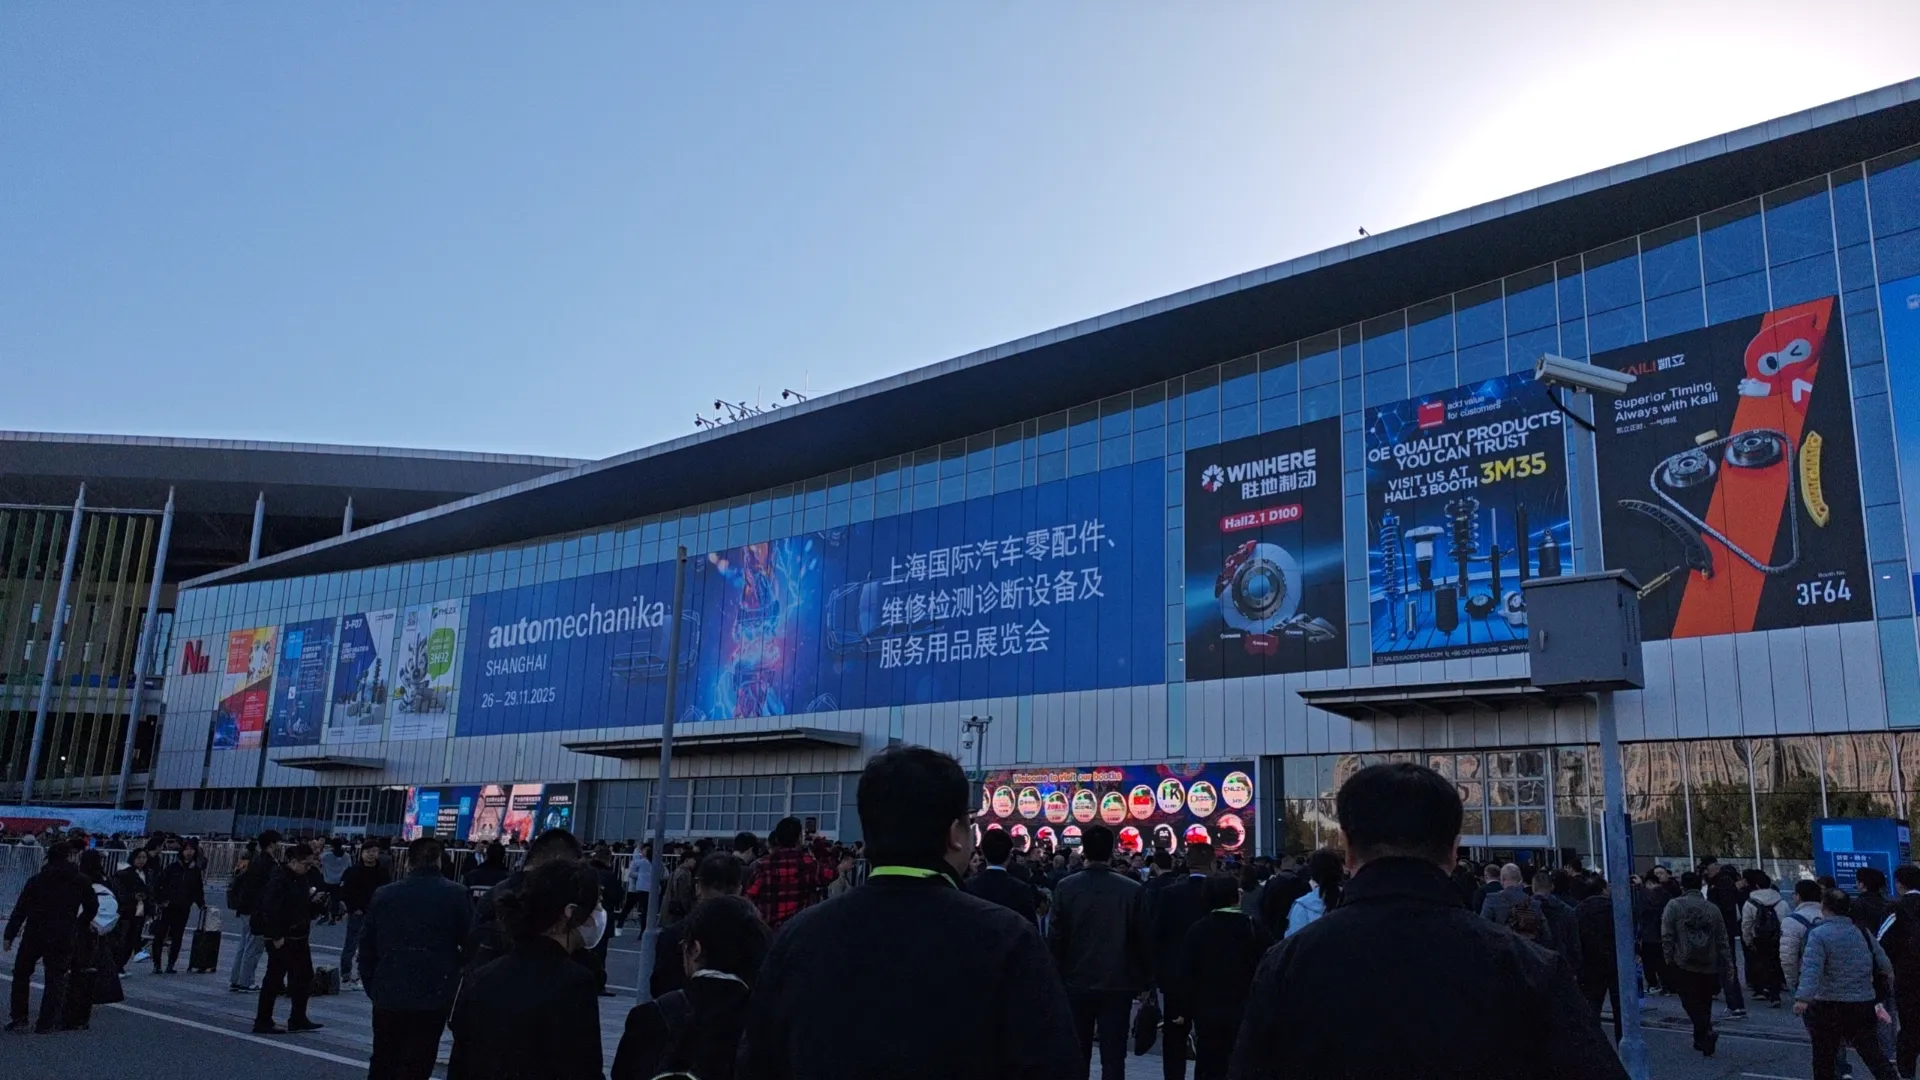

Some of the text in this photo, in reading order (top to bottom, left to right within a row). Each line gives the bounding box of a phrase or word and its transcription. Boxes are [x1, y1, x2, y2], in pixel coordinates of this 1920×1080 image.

[1657, 353, 1686, 371] 凯立
[1447, 399, 1463, 410] add
[1464, 395, 1485, 406] value
[1614, 392, 1666, 410] Superior
[1615, 391, 1719, 422] Always with Kaili
[1447, 411, 1458, 421] for
[1367, 410, 1562, 463] OE QUALITY PRODUCTS
[1226, 448, 1316, 483] WINHERE
[1396, 432, 1530, 471] YOU CAN TRUST
[1388, 466, 1469, 491] VISIT US AT
[1480, 451, 1547, 485] 3M35
[1241, 469, 1316, 500] 胜地制动
[1384, 476, 1478, 504] HALL 3 BOOTH
[1224, 506, 1299, 530] Hall2.1 D100
[882, 518, 1116, 587] 上海国际汽车零配件、
[881, 566, 1105, 627] 维修检测诊断设备及
[1796, 578, 1852, 606] 3F64
[488, 595, 665, 649] automechanika
[879, 618, 1050, 669] 服务用品展览会
[485, 654, 547, 677] SHANGHAI
[481, 692, 495, 708] 26
[504, 687, 556, 706] 29.11.2025
[1013, 771, 1122, 784] Welcome to visit our booths
